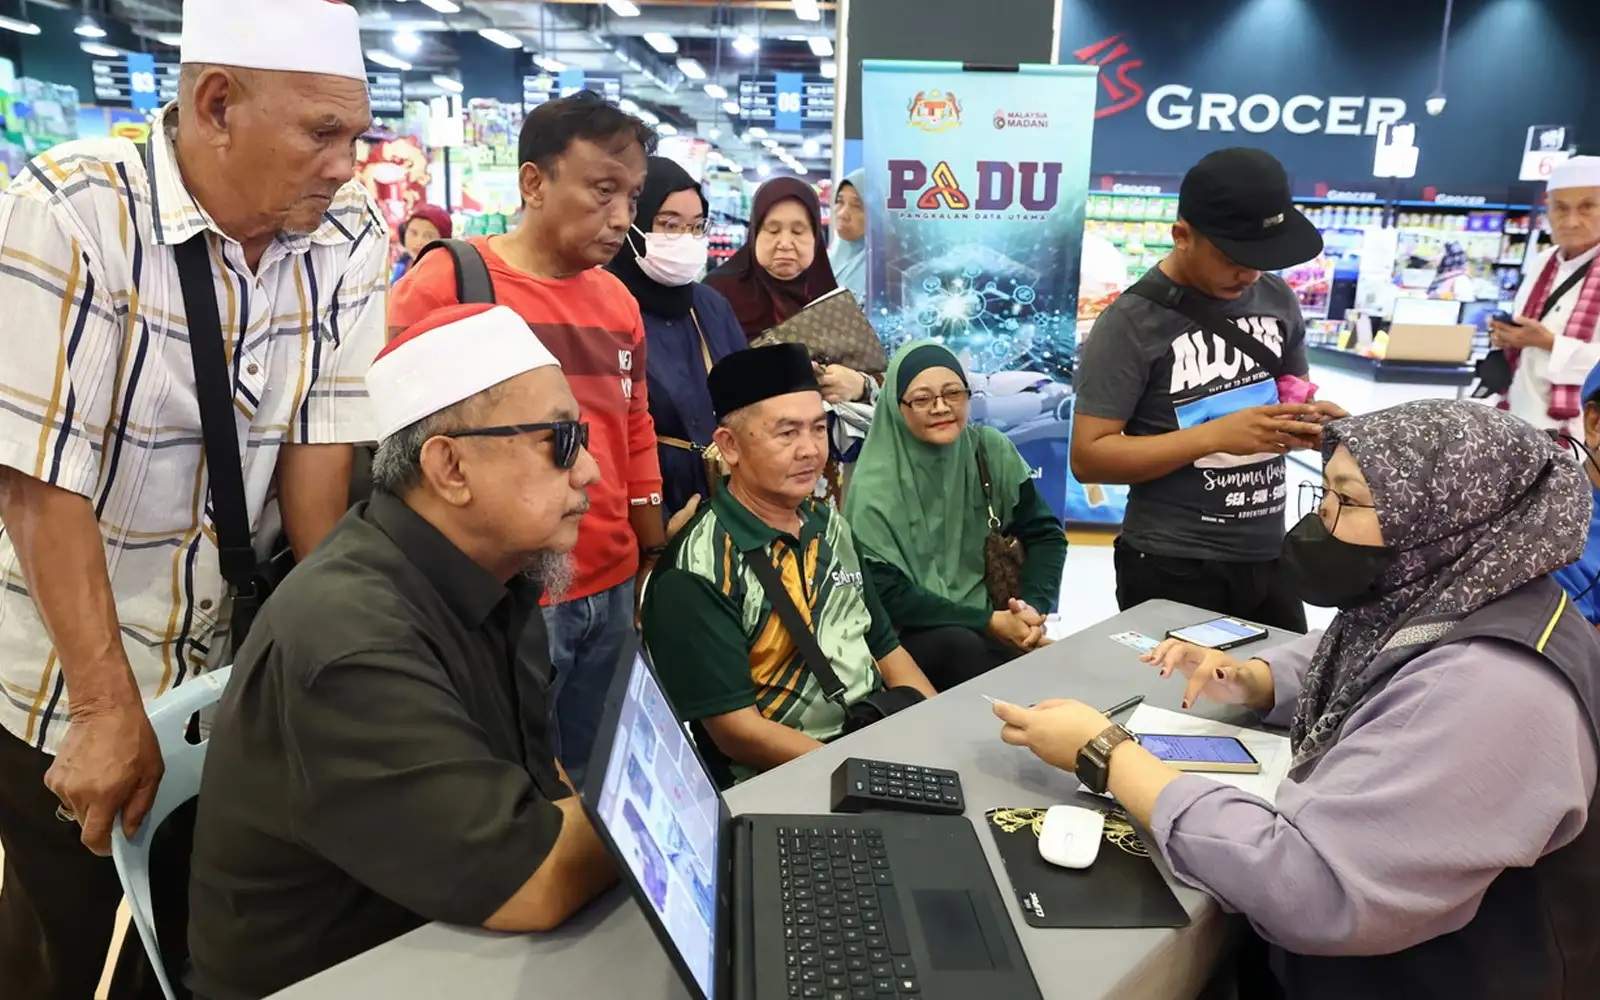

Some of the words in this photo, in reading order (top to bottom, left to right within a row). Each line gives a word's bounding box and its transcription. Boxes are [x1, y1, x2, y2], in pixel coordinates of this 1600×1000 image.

[1146, 84, 1406, 136] GROCER
[1007, 119, 1048, 128] MADANI
[887, 159, 1062, 211] PADU
[1203, 469, 1265, 491] Summer
[1225, 492, 1245, 507] SEA
